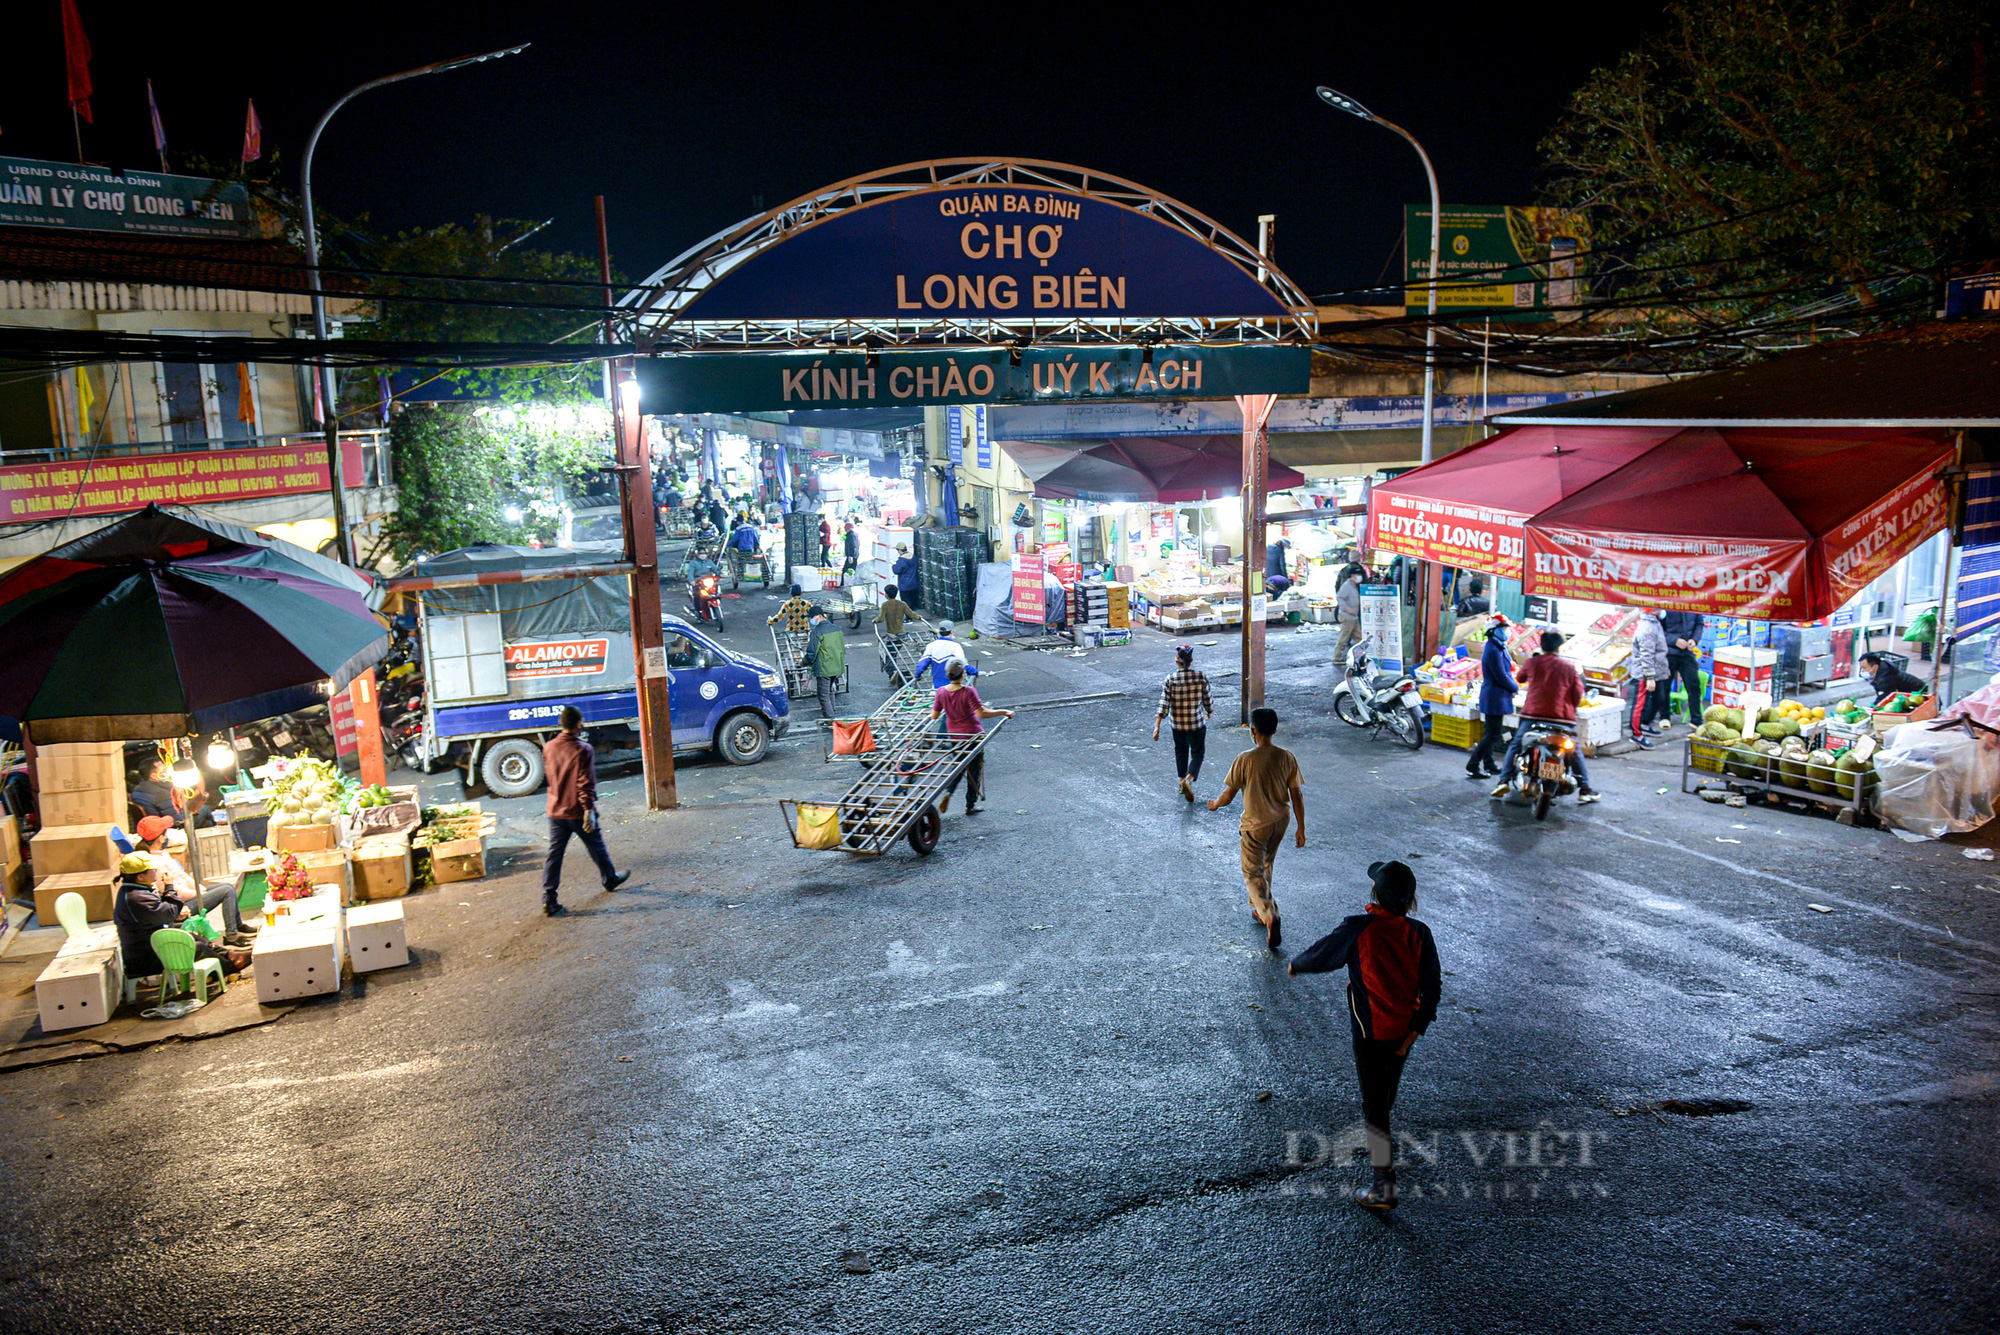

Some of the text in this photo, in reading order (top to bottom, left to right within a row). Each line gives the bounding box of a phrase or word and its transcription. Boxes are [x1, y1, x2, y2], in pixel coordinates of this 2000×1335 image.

[8, 165, 161, 188] UBND QUẬN BA ĐÌNH
[0, 177, 42, 206] UẢN
[50, 184, 75, 208] LÝ
[83, 190, 125, 216] CHỢ
[133, 194, 186, 217] LONG
[939, 193, 1081, 220] QUẬN BA ĐÌNH
[960, 221, 1063, 267] CHỢ
[896, 267, 1126, 310] LONG BIÊN
[782, 360, 876, 401] KÍNH
[889, 358, 995, 398] CHÀO
[0, 471, 34, 491] MỪNG
[34, 467, 49, 488] KỶ
[50, 468, 79, 489] NIỆM
[94, 465, 118, 483] NĂM
[119, 462, 145, 480] NGÀY
[146, 460, 177, 478] THÀNH
[178, 458, 195, 478] LẬP
[197, 456, 222, 476] QUẬN
[222, 458, 235, 472] BA
[235, 454, 256, 471] ĐÌNH
[10, 498, 26, 515] 60
[26, 494, 53, 513] NĂM
[83, 488, 116, 507] THÀNH
[117, 485, 135, 506] LẬP
[137, 481, 164, 502] ĐẢNG
[164, 481, 178, 501] BỘ
[179, 479, 204, 499] QUẬN
[204, 480, 218, 495] BA
[218, 477, 240, 494] ĐÌNH
[1378, 511, 1439, 541] HUYỀN
[1442, 524, 1494, 552] LONG
[1551, 532, 1576, 546] CÔNG
[1685, 542, 1703, 557] MẠI
[1705, 543, 1726, 555] HOA
[1834, 515, 1898, 578] HUYỀN
[1628, 561, 1707, 589] LONG
[1715, 562, 1791, 595] BIÊN
[505, 644, 599, 662] ALAMOVE
[515, 662, 531, 670] Giao
[531, 661, 548, 669] hàng
[563, 658, 573, 667] tốc
